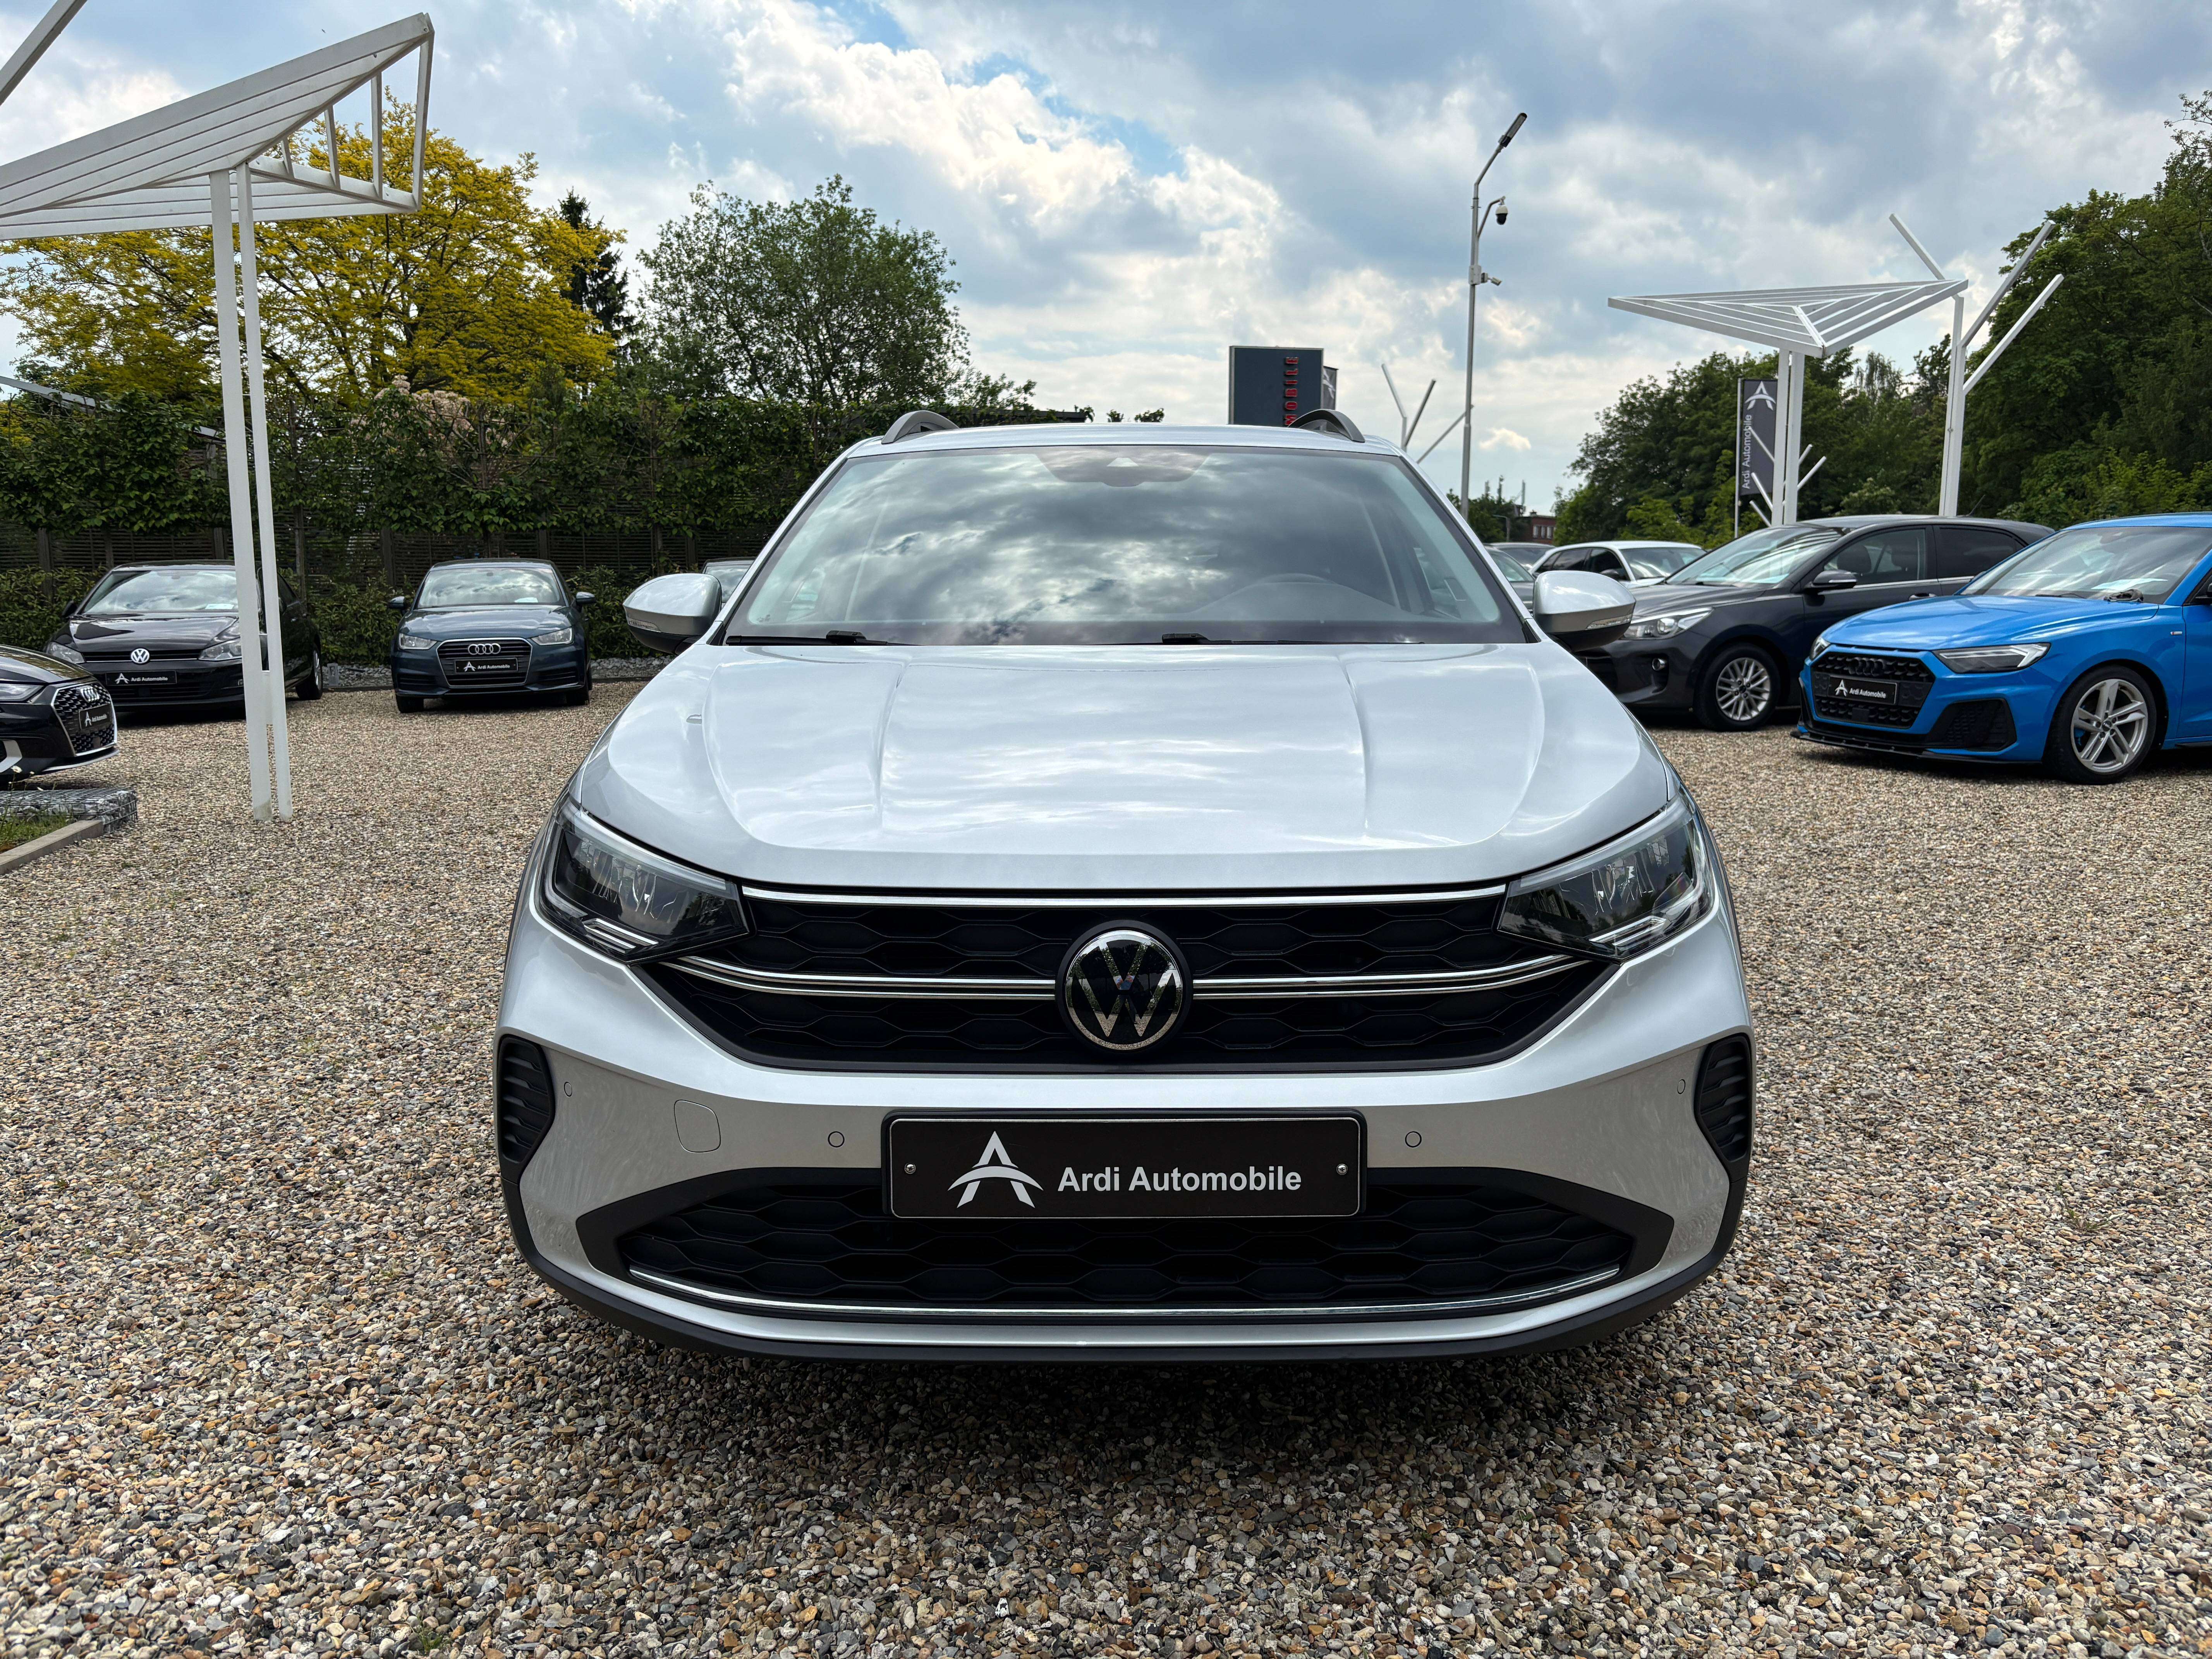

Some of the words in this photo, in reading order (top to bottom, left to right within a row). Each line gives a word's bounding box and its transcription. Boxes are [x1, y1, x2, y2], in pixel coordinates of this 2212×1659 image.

[1742, 414, 1752, 467] Automobile
[1742, 470, 1750, 489] Ardi
[1859, 689, 1886, 699] Automobile
[1058, 1166, 1120, 1192] Ardi
[1128, 1166, 1302, 1191] Automobile
